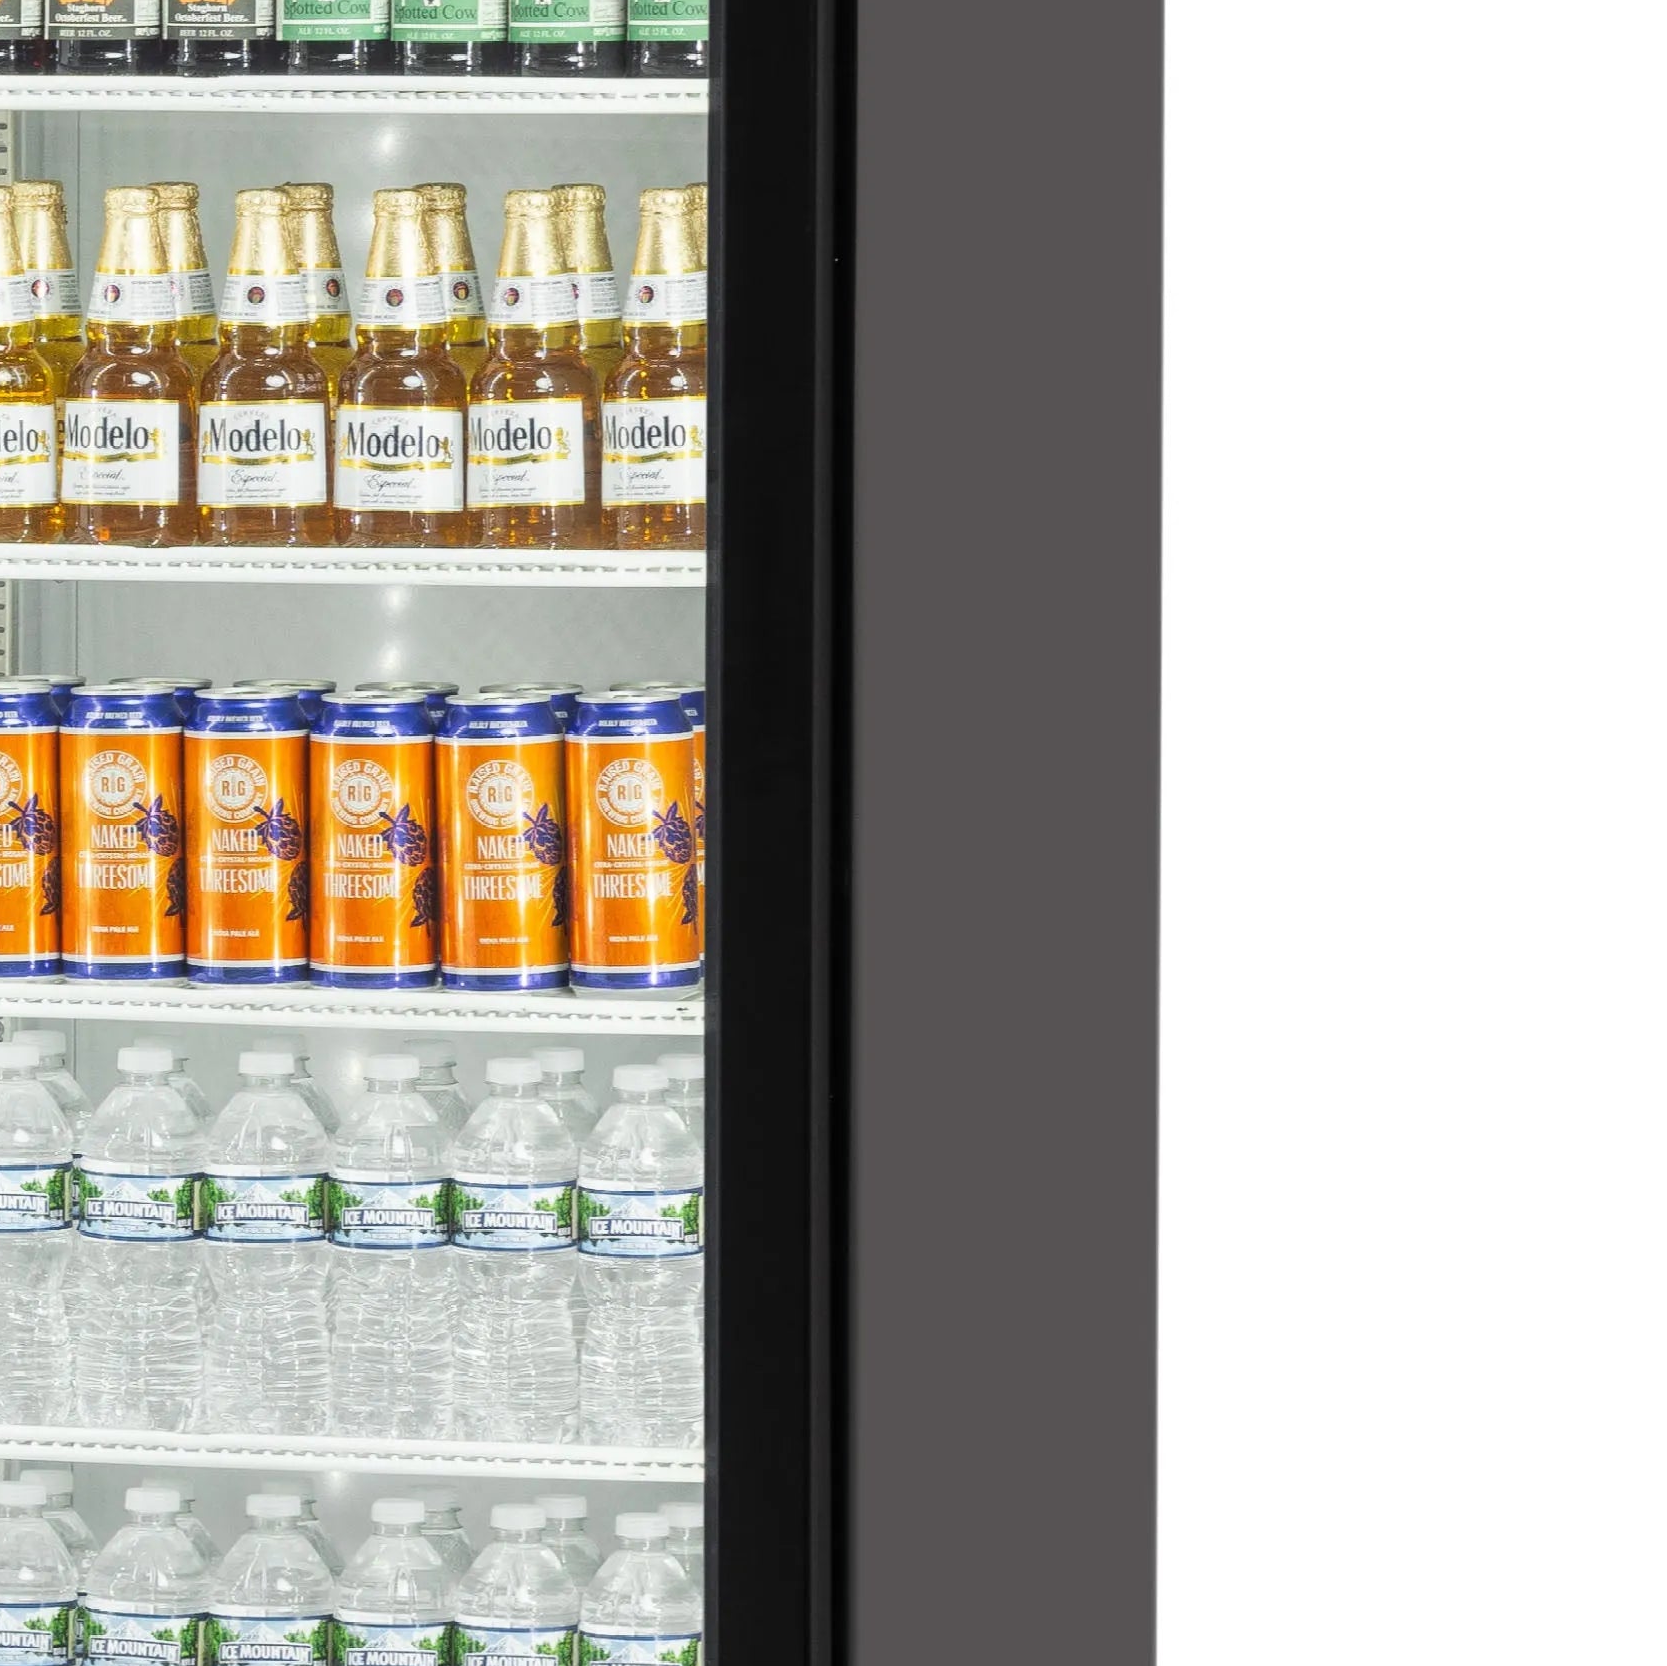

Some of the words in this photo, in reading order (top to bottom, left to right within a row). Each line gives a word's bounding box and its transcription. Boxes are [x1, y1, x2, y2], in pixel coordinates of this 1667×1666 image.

[209, 418, 300, 453] Modelo
[346, 426, 439, 462] Modelo
[344, 1210, 361, 1225] ICE
[363, 1210, 433, 1228] MOUNTAIN
[592, 1219, 607, 1234] ICE
[609, 1220, 682, 1239] MOUNTAIN
